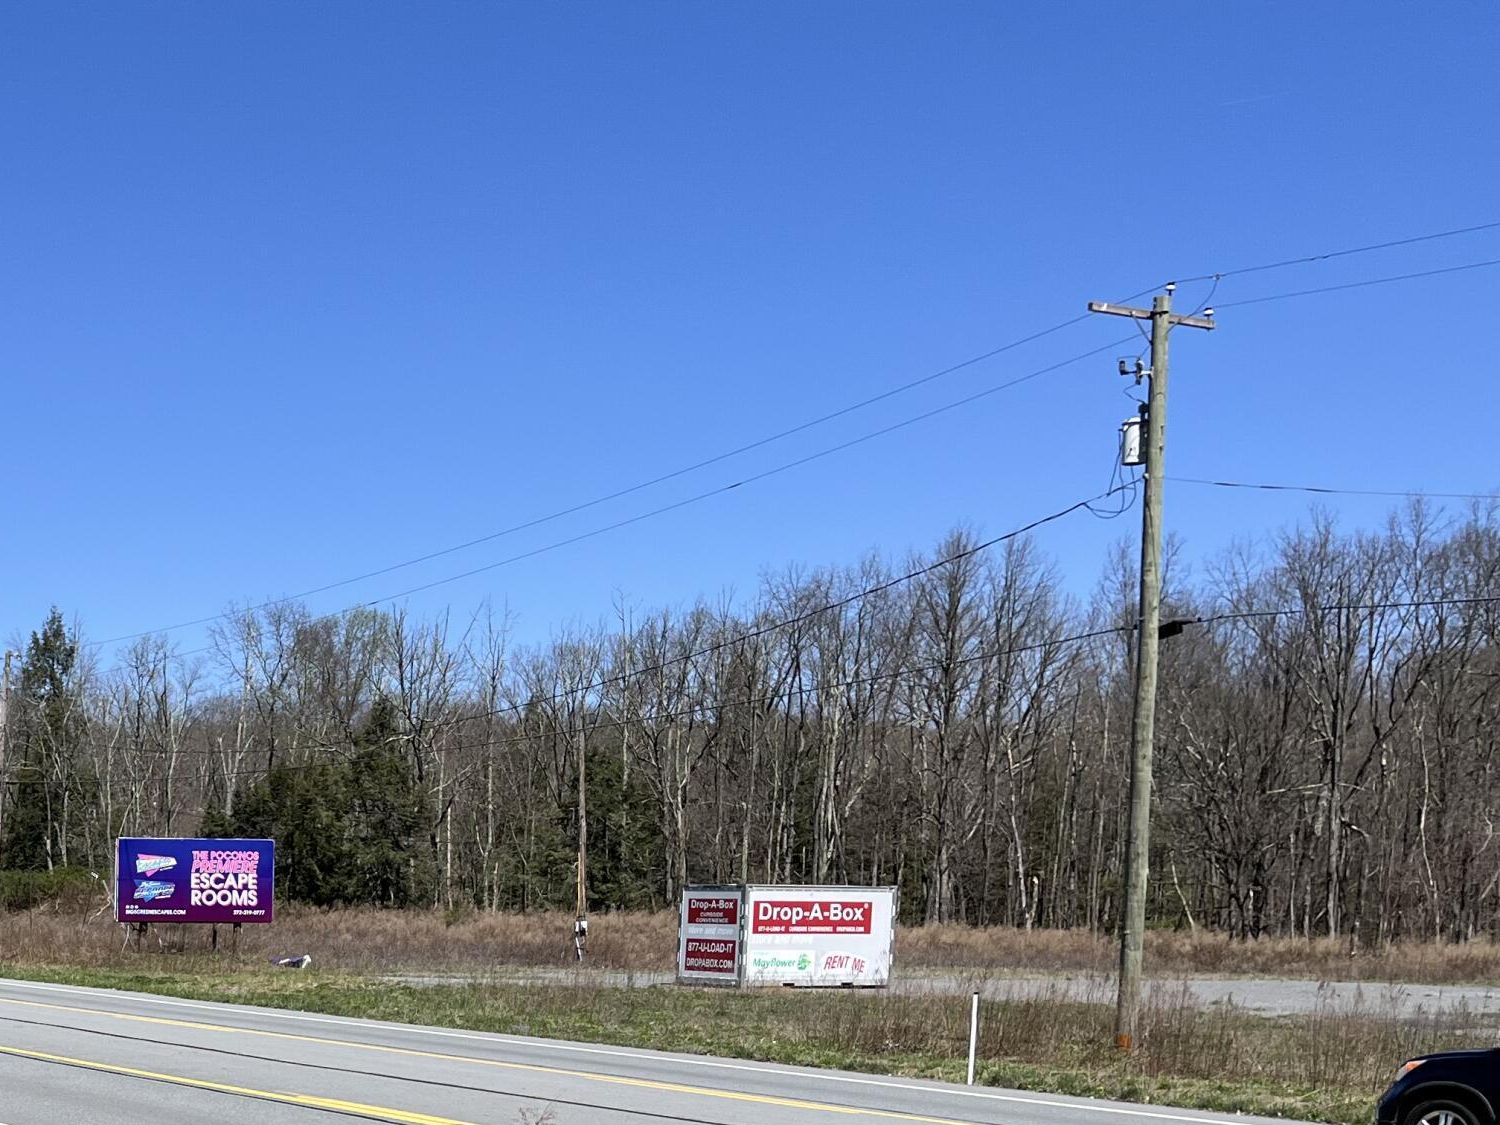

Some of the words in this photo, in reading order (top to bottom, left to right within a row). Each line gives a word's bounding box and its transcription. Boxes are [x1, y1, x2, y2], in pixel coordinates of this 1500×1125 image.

[192, 851, 209, 860] THE
[210, 850, 259, 861] POCONOS
[191, 860, 258, 874] PREMIERE
[191, 873, 258, 889] ESCAPE
[191, 889, 258, 906] ROOMS
[690, 899, 734, 911] Drop-A-Box
[687, 942, 734, 953] 877-U-LOAD-IT
[686, 957, 733, 969] DROPABOX.COM
[753, 958, 796, 969] Mayflower
[823, 955, 850, 970] RENT
[851, 957, 866, 973] ME
